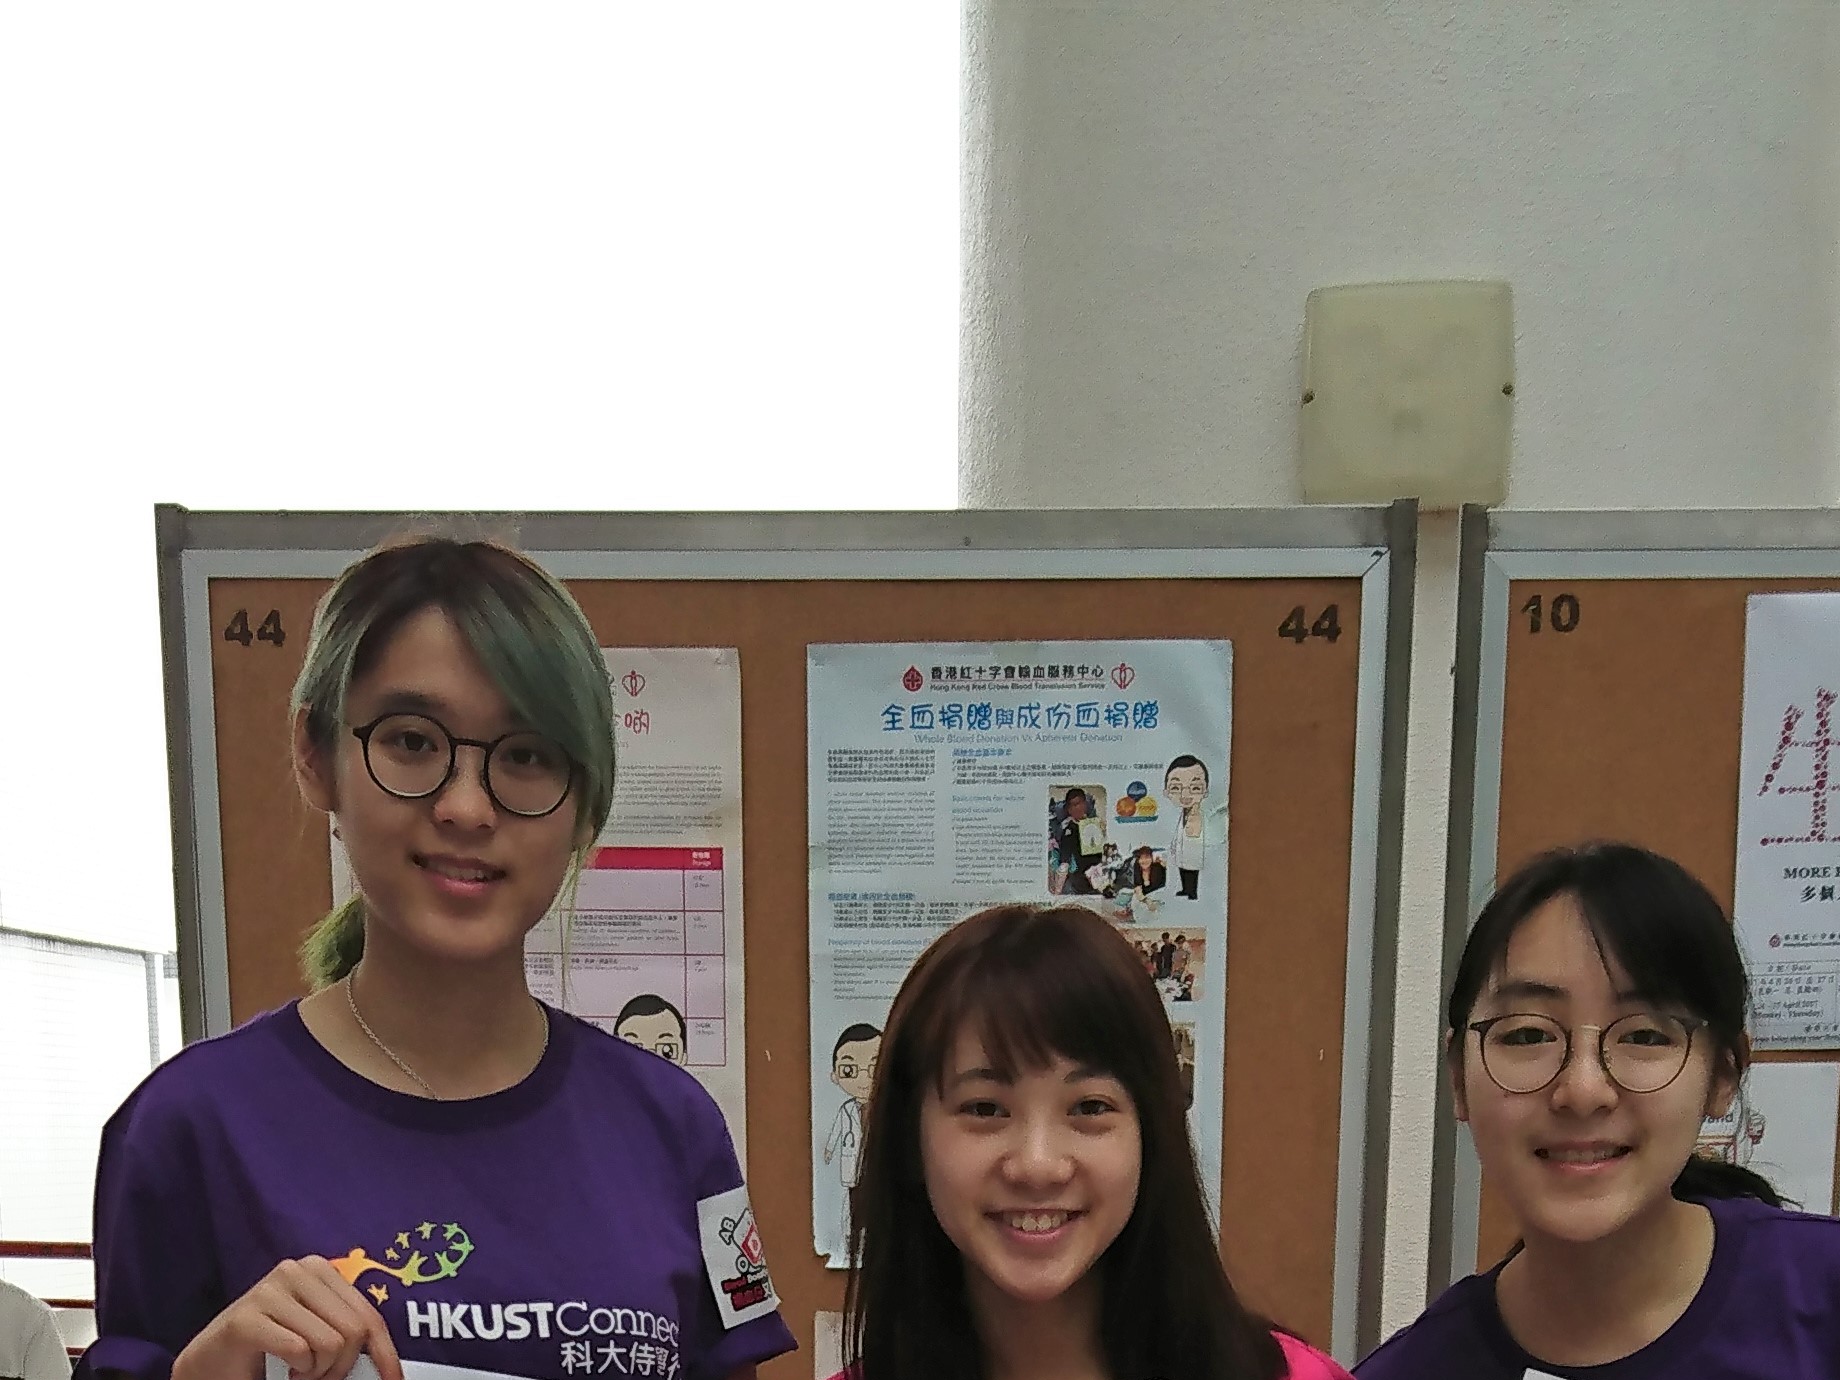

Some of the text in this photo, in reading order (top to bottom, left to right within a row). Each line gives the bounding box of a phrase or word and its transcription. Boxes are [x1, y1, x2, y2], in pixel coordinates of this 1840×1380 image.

[225, 609, 286, 647] 44
[1278, 604, 1342, 643] 44
[1521, 595, 1579, 633] 10
[1784, 867, 1830, 879] MORE
